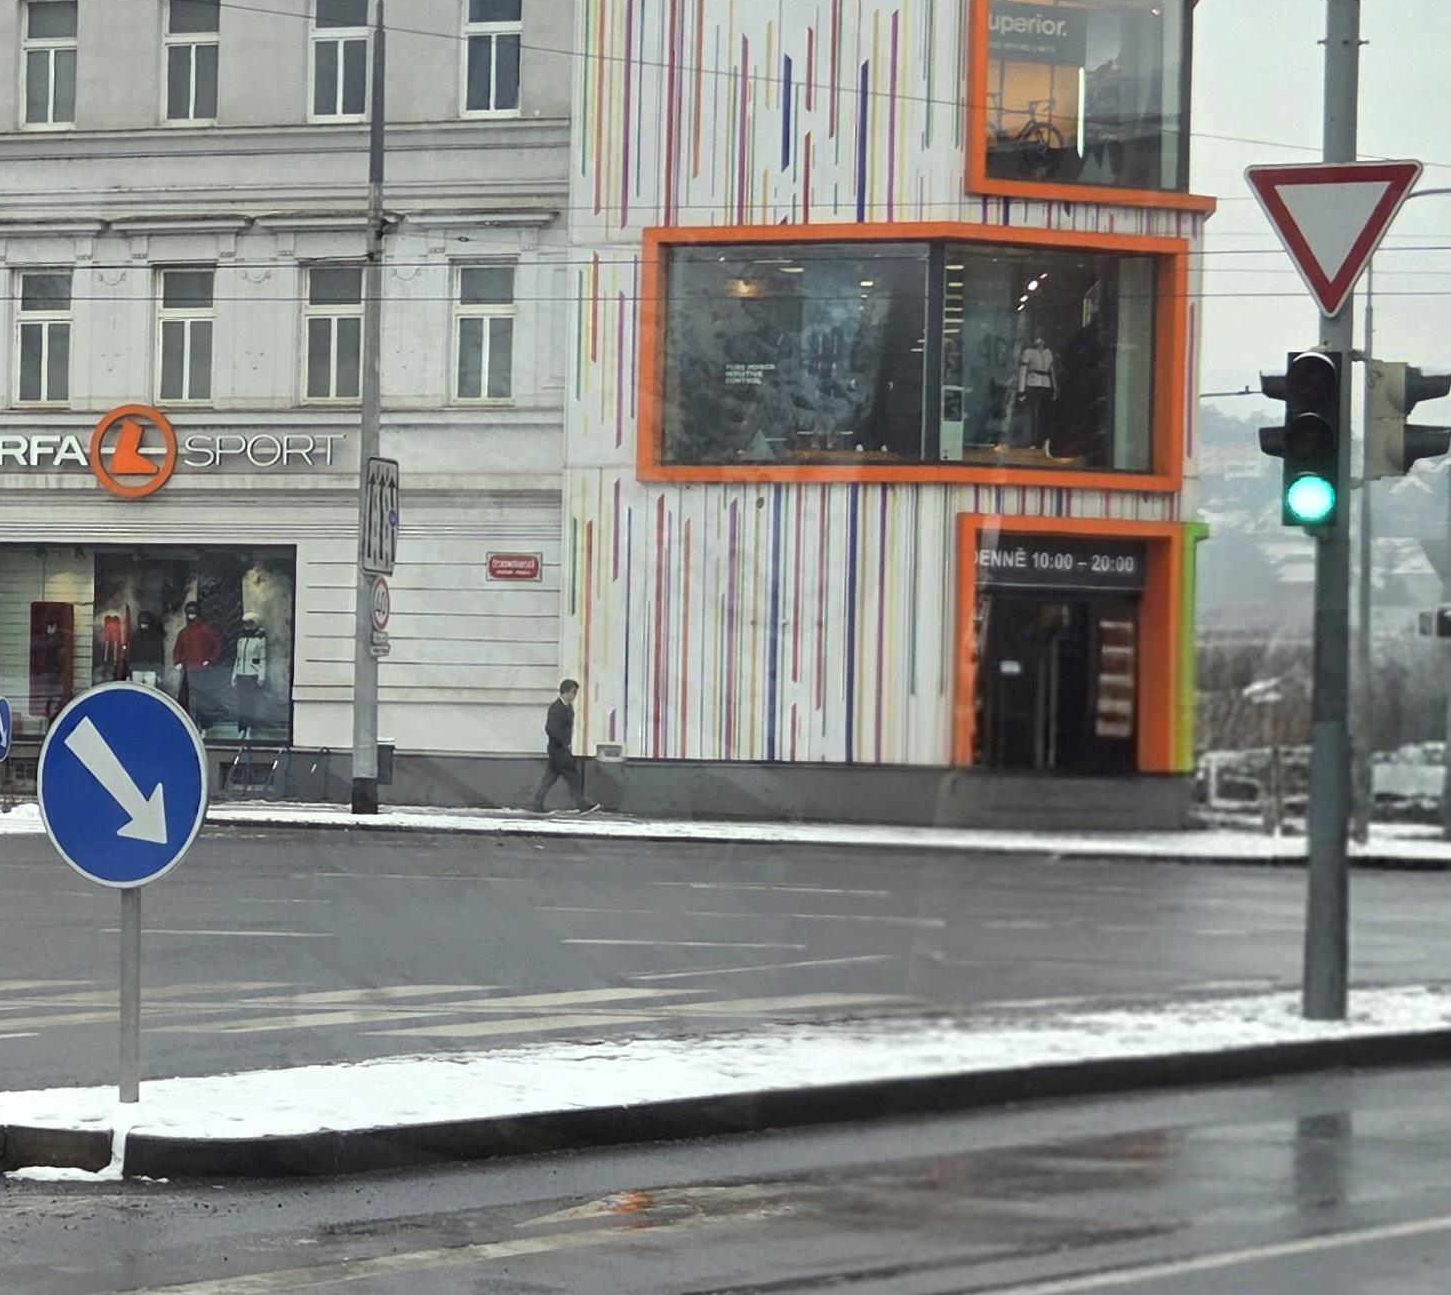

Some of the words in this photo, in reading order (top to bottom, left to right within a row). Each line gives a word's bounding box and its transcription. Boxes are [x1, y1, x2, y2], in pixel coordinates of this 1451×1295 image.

[183, 435, 346, 467] SPORT
[1031, 552, 1074, 570] 10:00
[1091, 555, 1135, 572] 20:00
